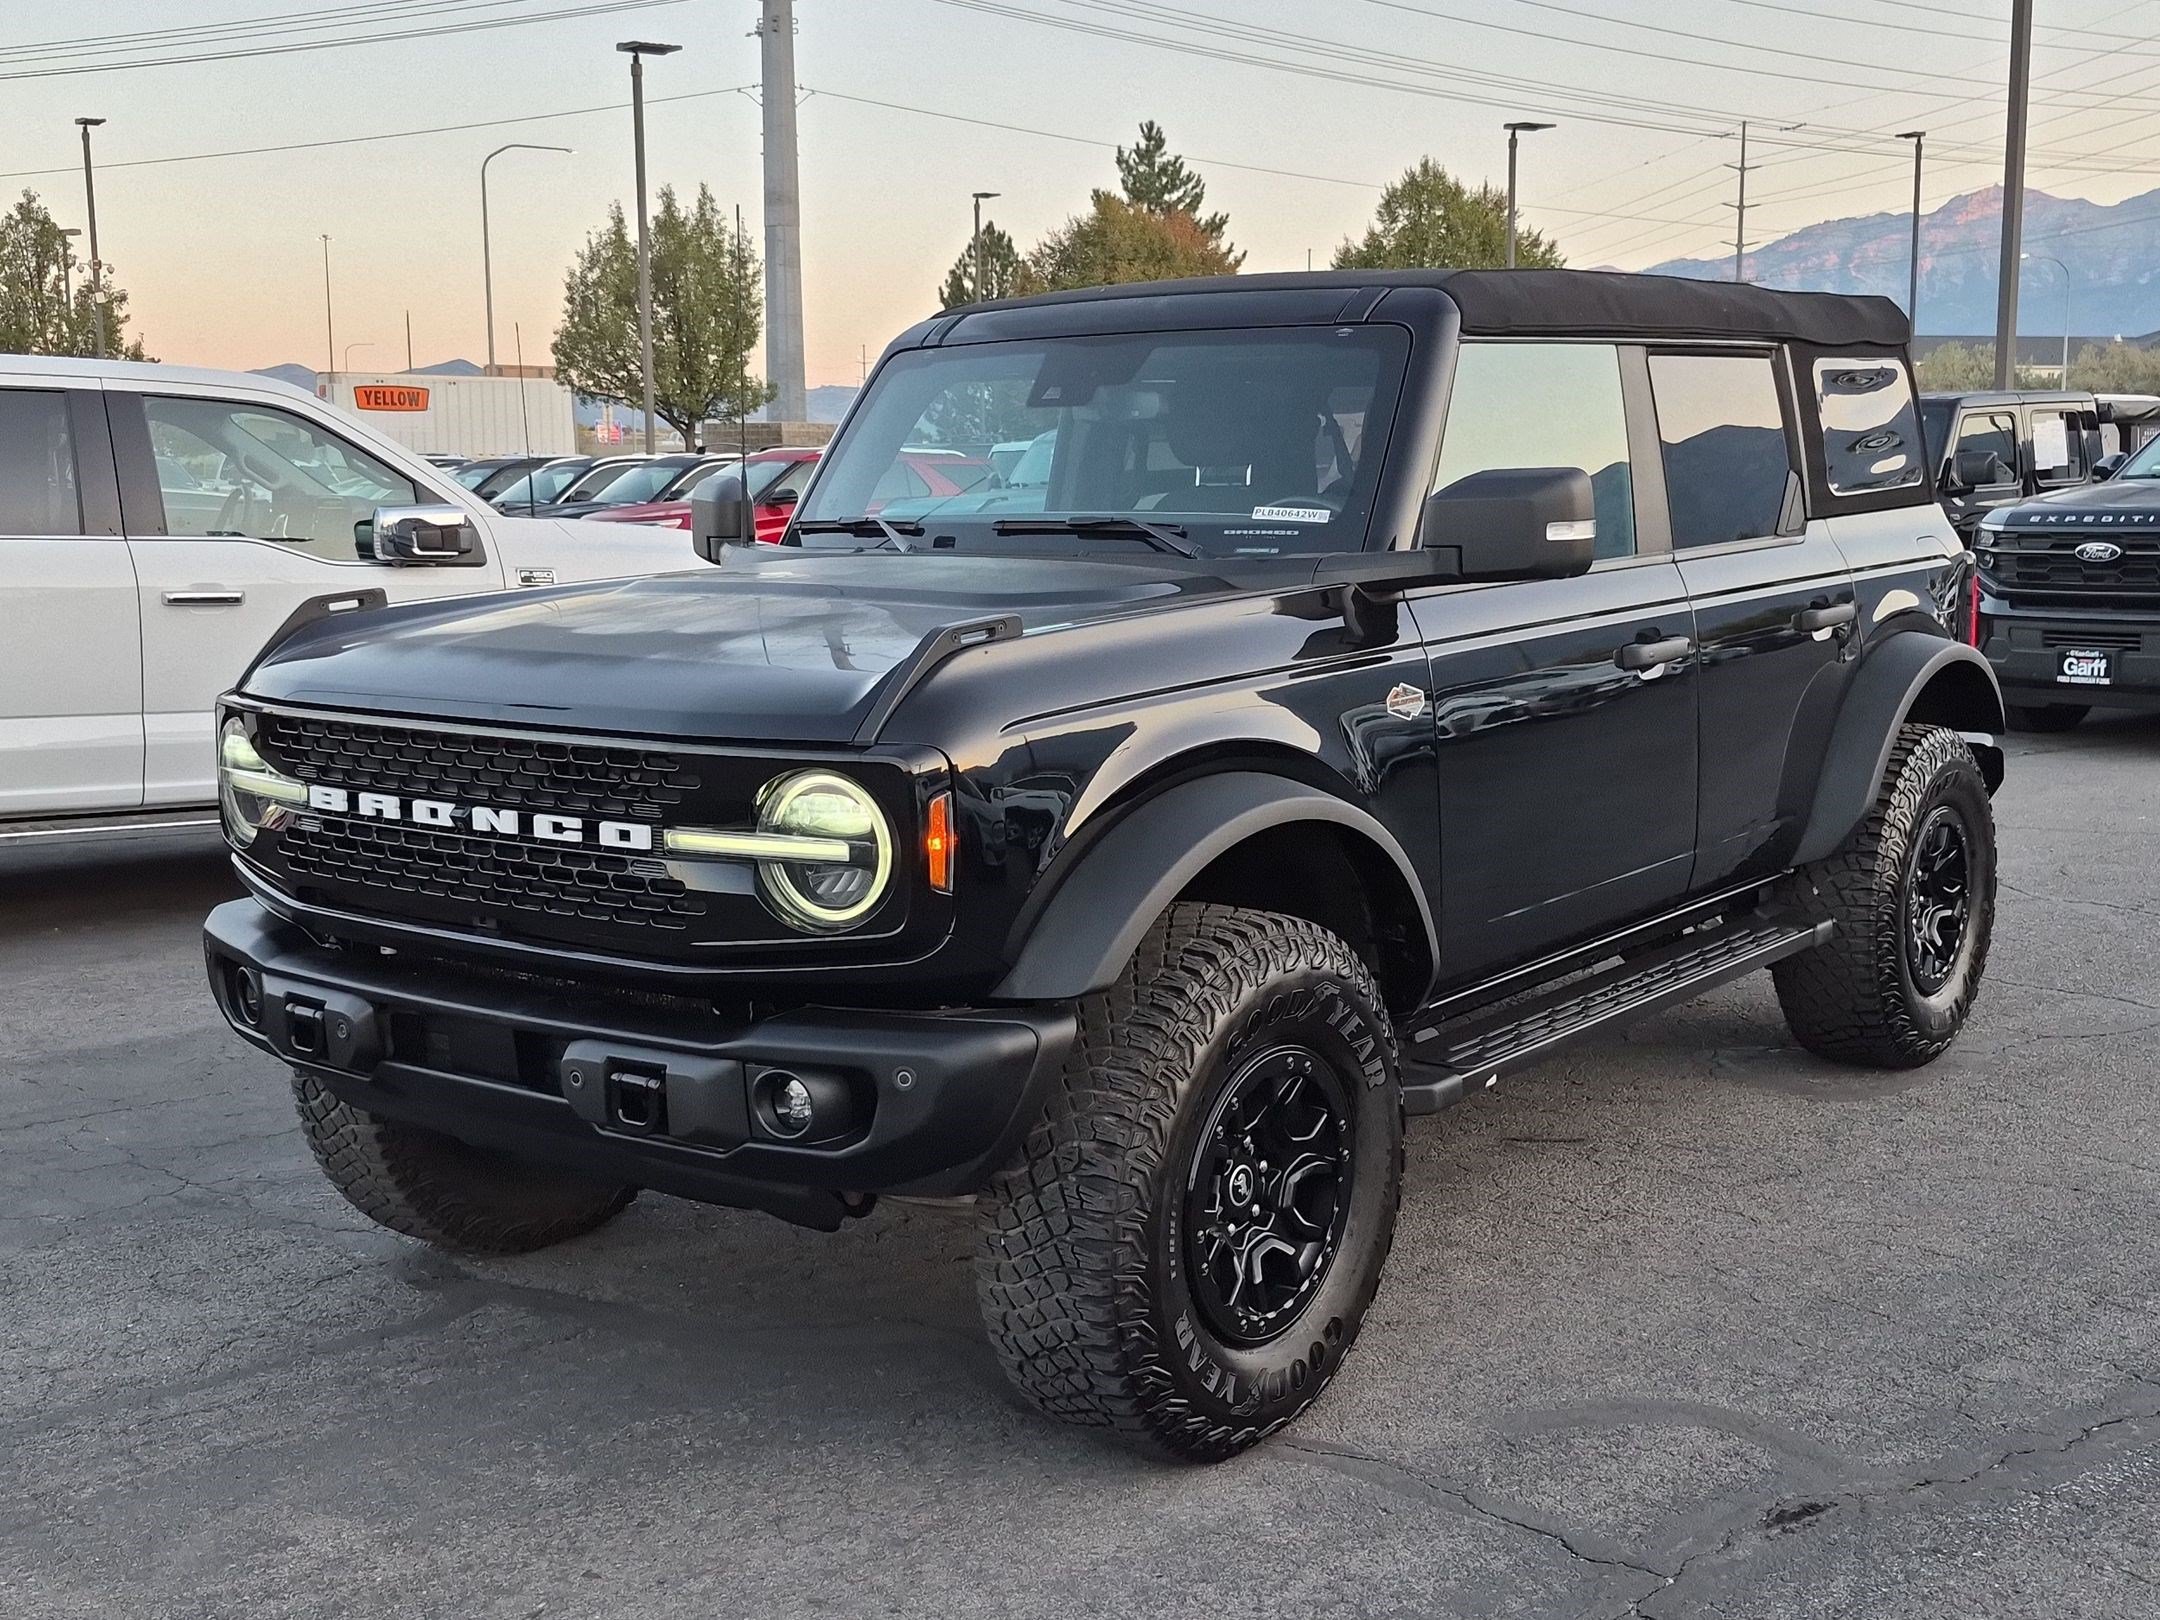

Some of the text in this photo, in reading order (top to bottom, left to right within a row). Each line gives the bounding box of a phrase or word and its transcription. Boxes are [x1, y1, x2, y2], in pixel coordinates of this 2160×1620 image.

[363, 390, 421, 407] YELLOW
[1254, 508, 1319, 519] PLB40642W
[2082, 545, 2112, 559] Ford
[2063, 657, 2107, 677] Garff
[309, 785, 651, 850] BRONCO
